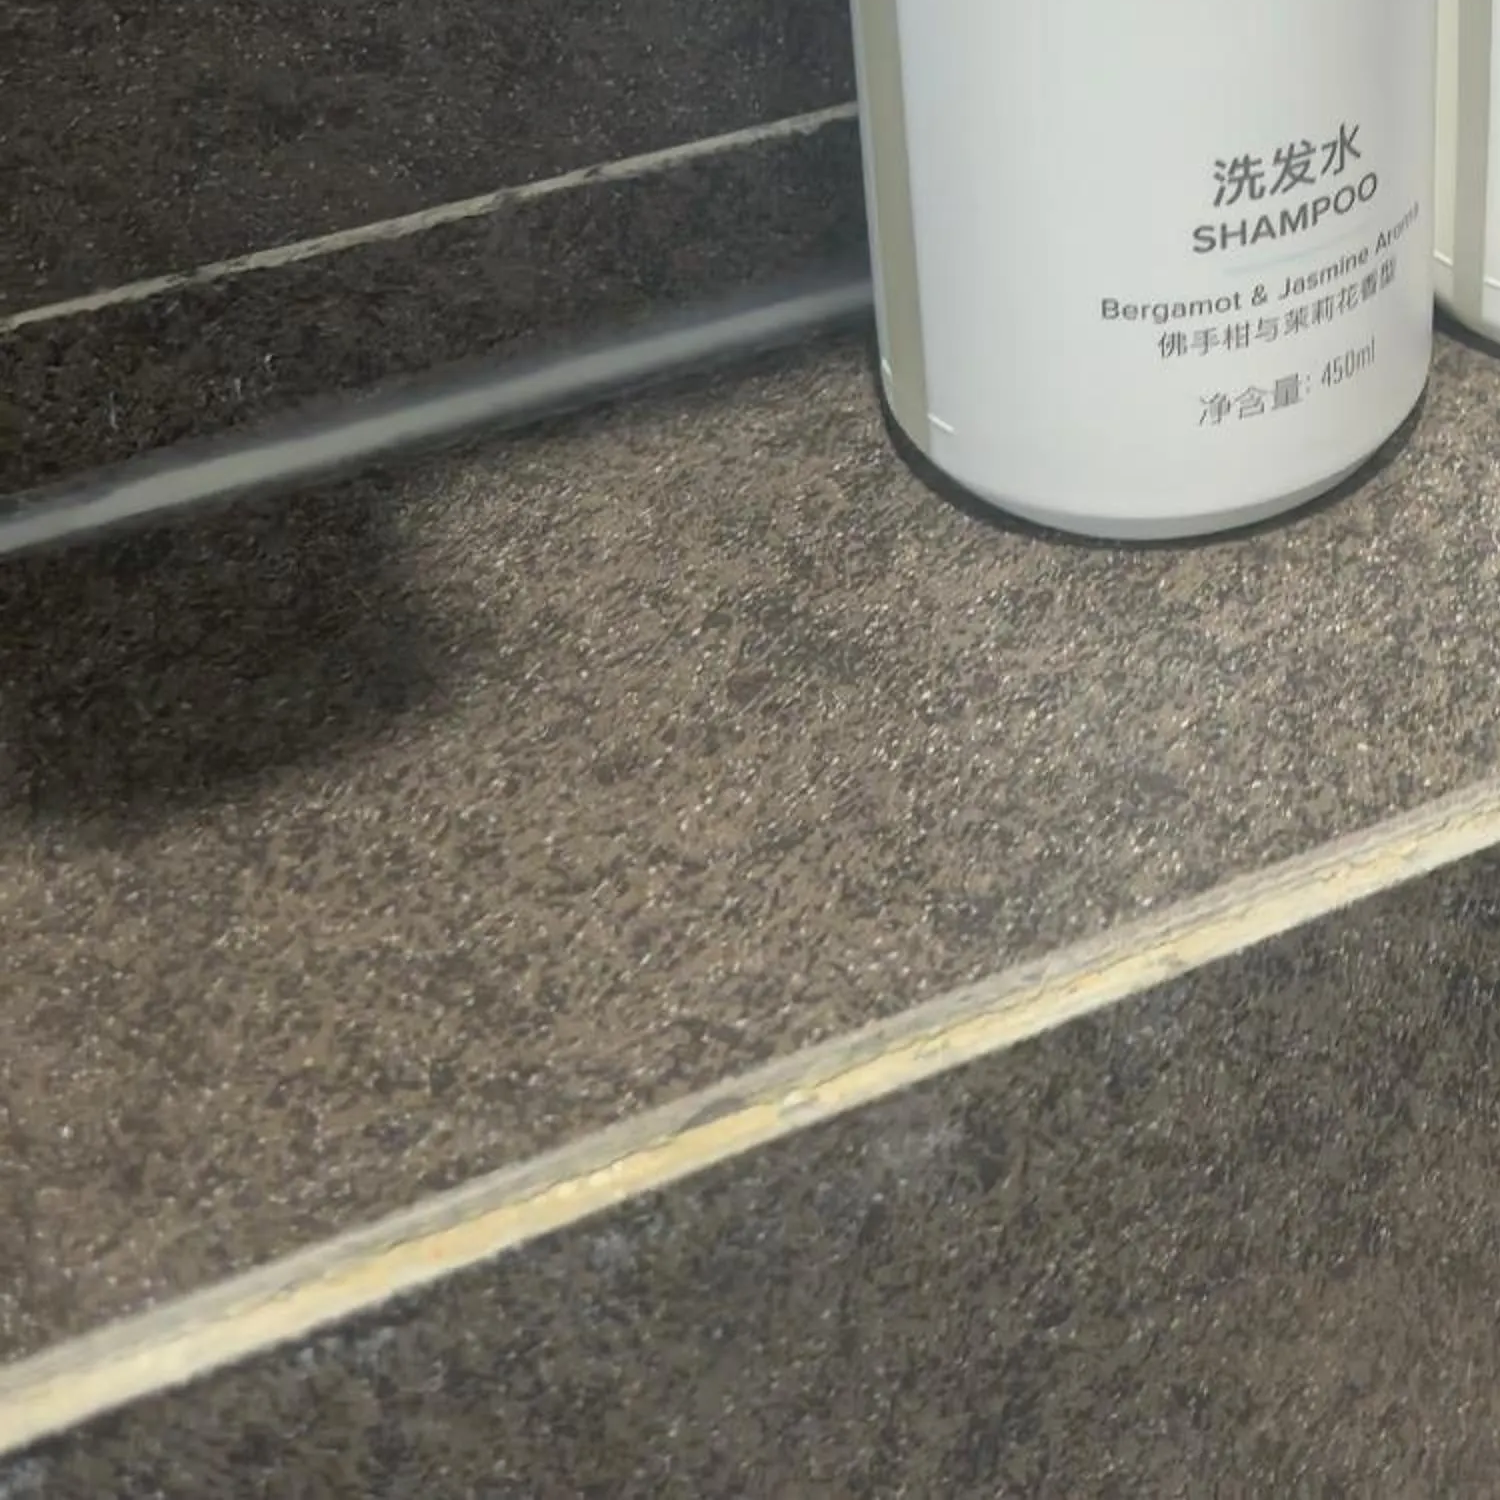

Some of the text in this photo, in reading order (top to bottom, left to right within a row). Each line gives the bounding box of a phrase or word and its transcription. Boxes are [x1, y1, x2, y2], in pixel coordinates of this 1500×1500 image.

[1212, 121, 1362, 208] 洗发水
[1191, 171, 1379, 253] SHAMPOO
[1101, 291, 1242, 325] Bergamot
[1251, 283, 1269, 307] &
[1277, 246, 1370, 301] Jasmine
[1320, 335, 1376, 388] 450ml
